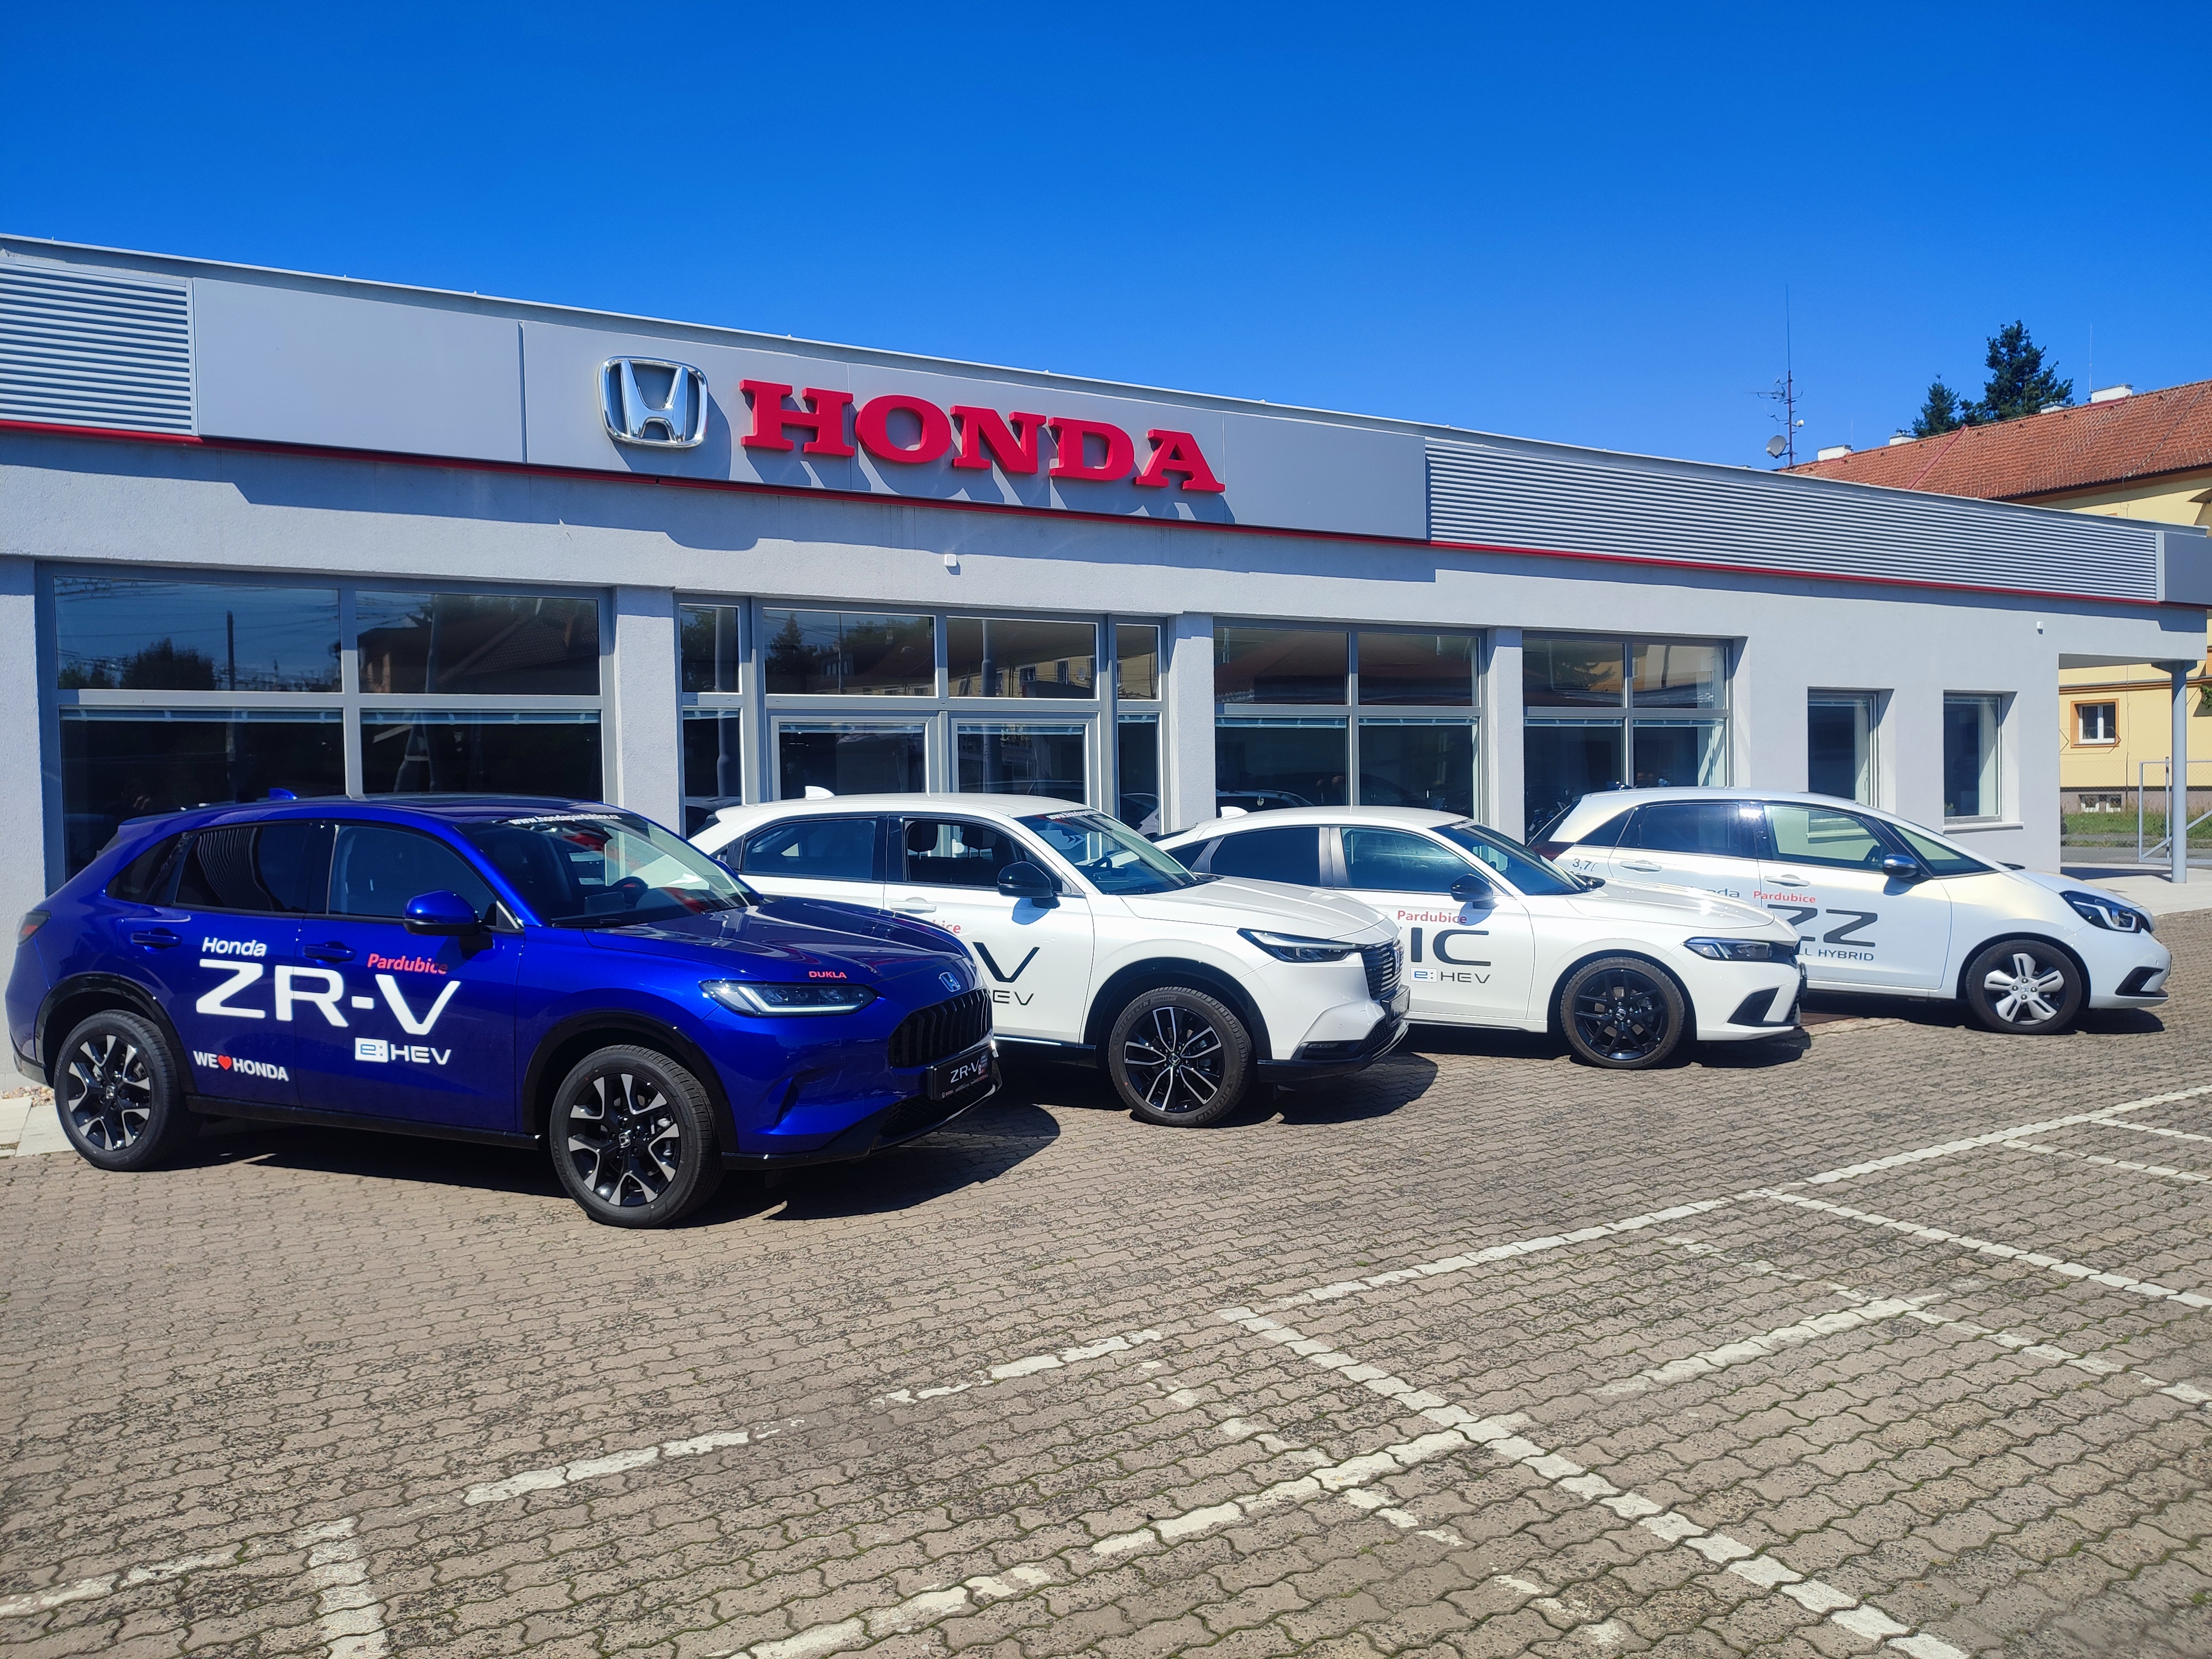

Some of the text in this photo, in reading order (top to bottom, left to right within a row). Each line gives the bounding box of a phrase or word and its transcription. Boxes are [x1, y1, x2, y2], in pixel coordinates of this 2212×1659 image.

[740, 379, 1225, 493] HONDA
[1753, 890, 1815, 903] Pardubice
[1397, 910, 1468, 924] Pardubice
[201, 937, 448, 975] Honda Pardubice
[1818, 949, 1874, 961] HYBRID
[196, 958, 461, 1036] ZR-V
[232, 1057, 289, 1082] HONDA
[950, 1058, 980, 1083] ZR-V
